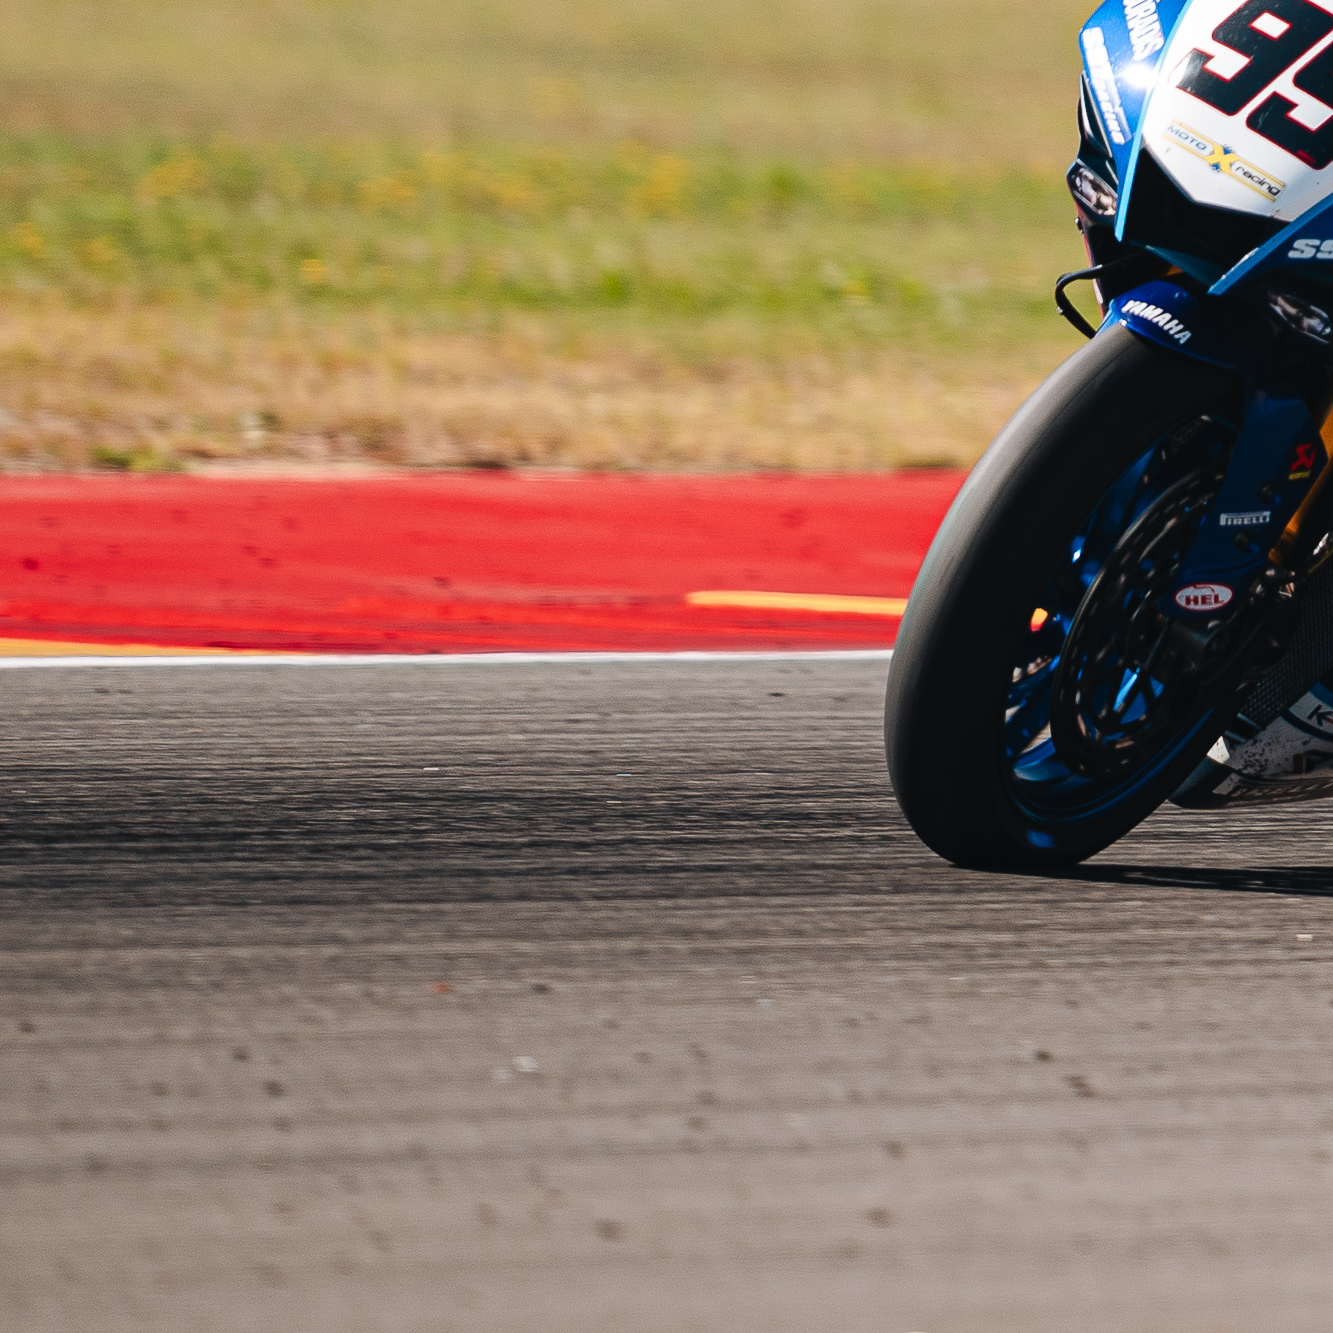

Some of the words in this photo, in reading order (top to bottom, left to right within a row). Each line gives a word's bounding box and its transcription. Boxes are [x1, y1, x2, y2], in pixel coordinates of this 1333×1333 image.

[1167, 125, 1207, 151] MOTO
[1235, 166, 1281, 197] racing
[1123, 300, 1192, 345] YAMAHA
[1219, 511, 1271, 526] PIRELLI
[1185, 595, 1224, 606] HEL
